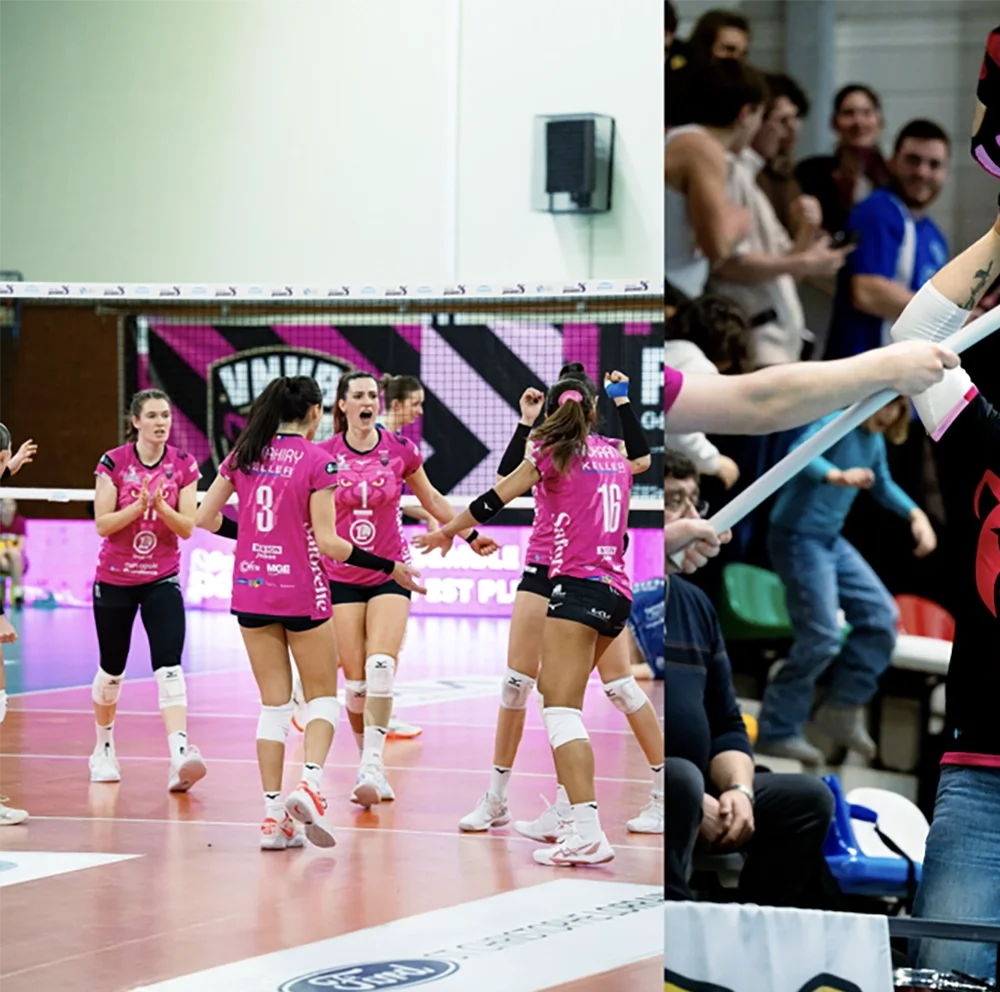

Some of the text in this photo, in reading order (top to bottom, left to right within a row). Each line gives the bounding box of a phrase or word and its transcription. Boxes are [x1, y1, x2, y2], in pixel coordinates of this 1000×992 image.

[256, 485, 274, 532] 3
[597, 483, 622, 533] 16
[307, 965, 436, 992] Ford
